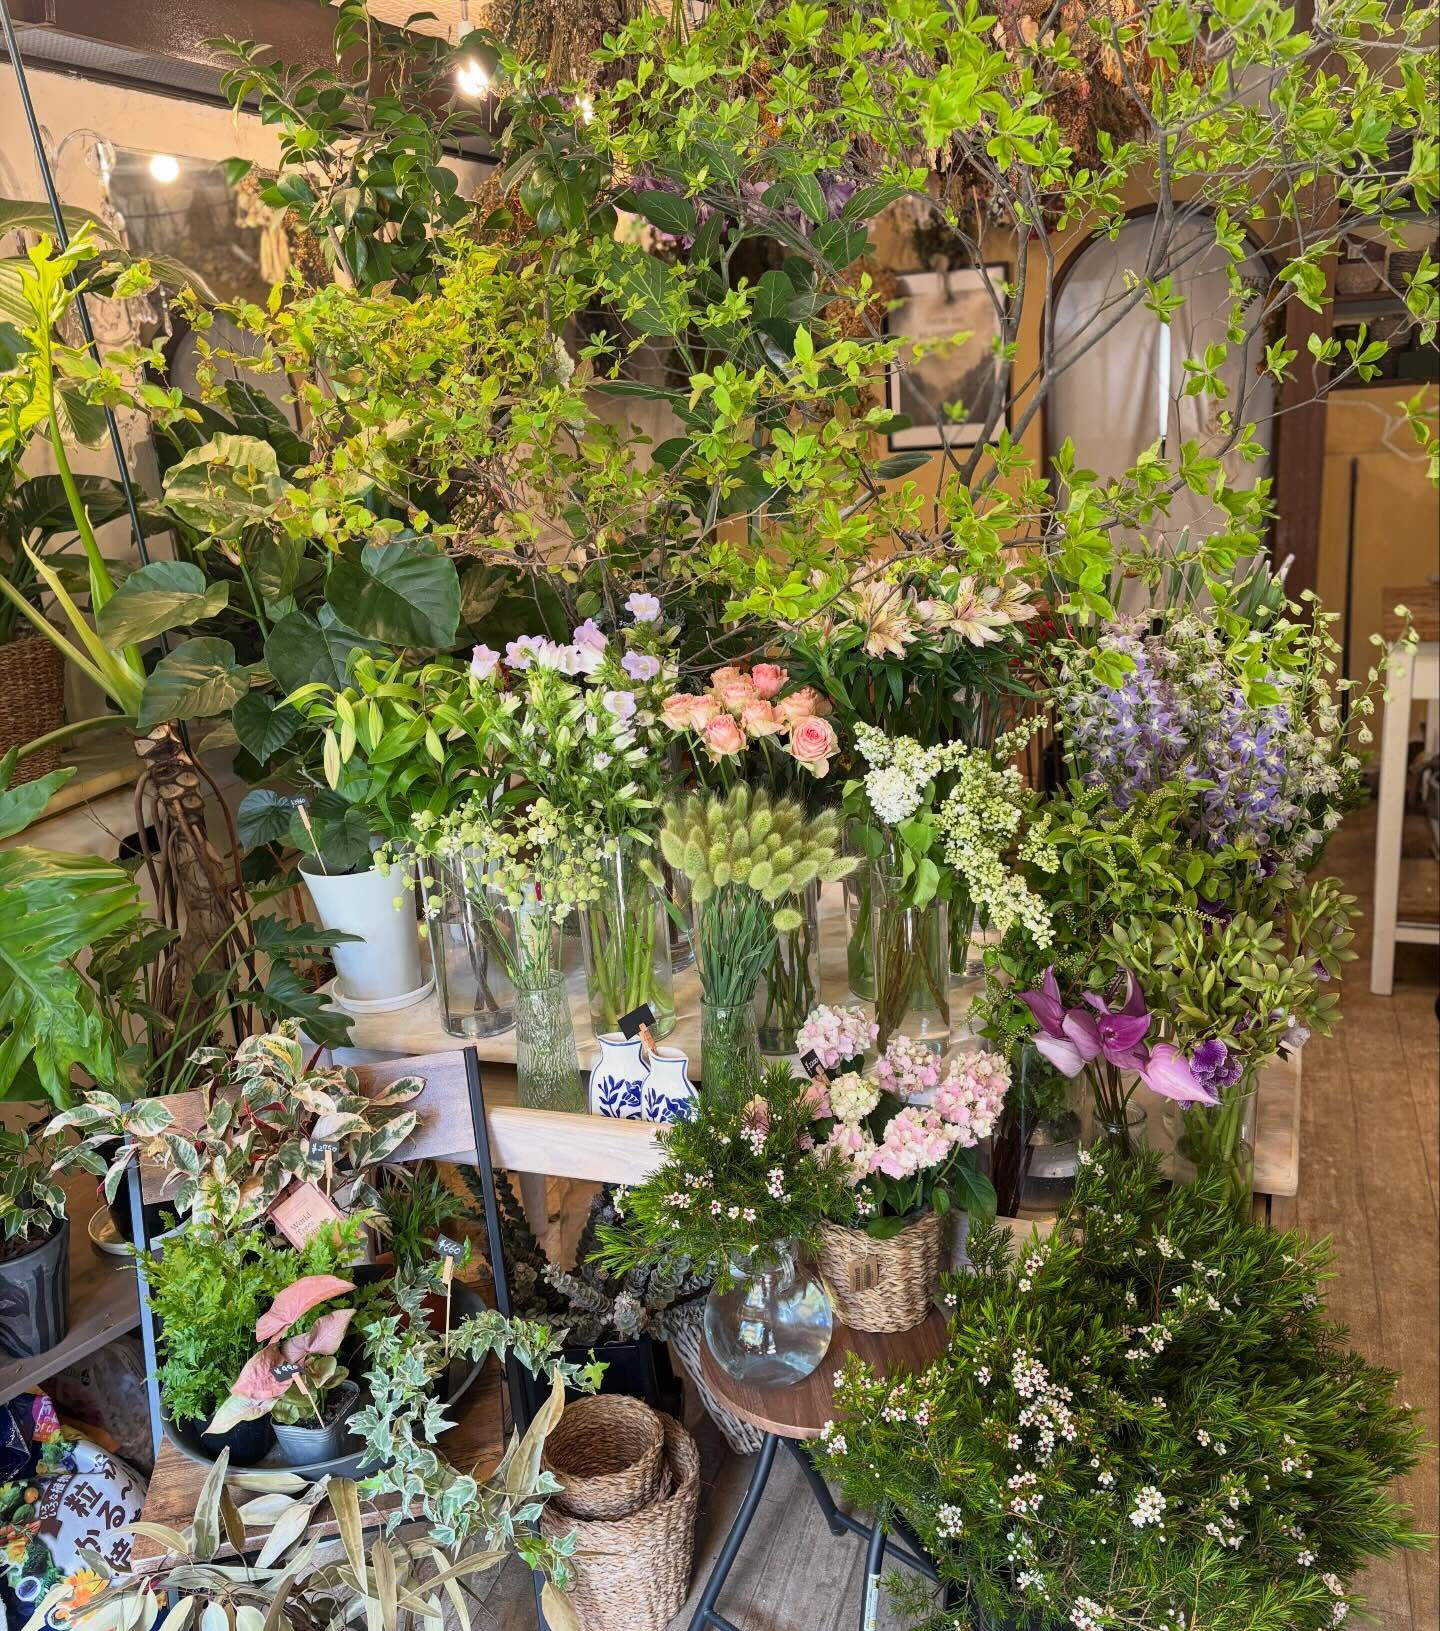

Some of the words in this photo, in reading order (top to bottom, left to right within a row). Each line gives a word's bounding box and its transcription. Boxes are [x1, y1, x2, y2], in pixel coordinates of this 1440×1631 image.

[289, 1211, 312, 1230] World
[438, 1239, 461, 1255] ¥660
[273, 1364, 299, 1375] ¥990
